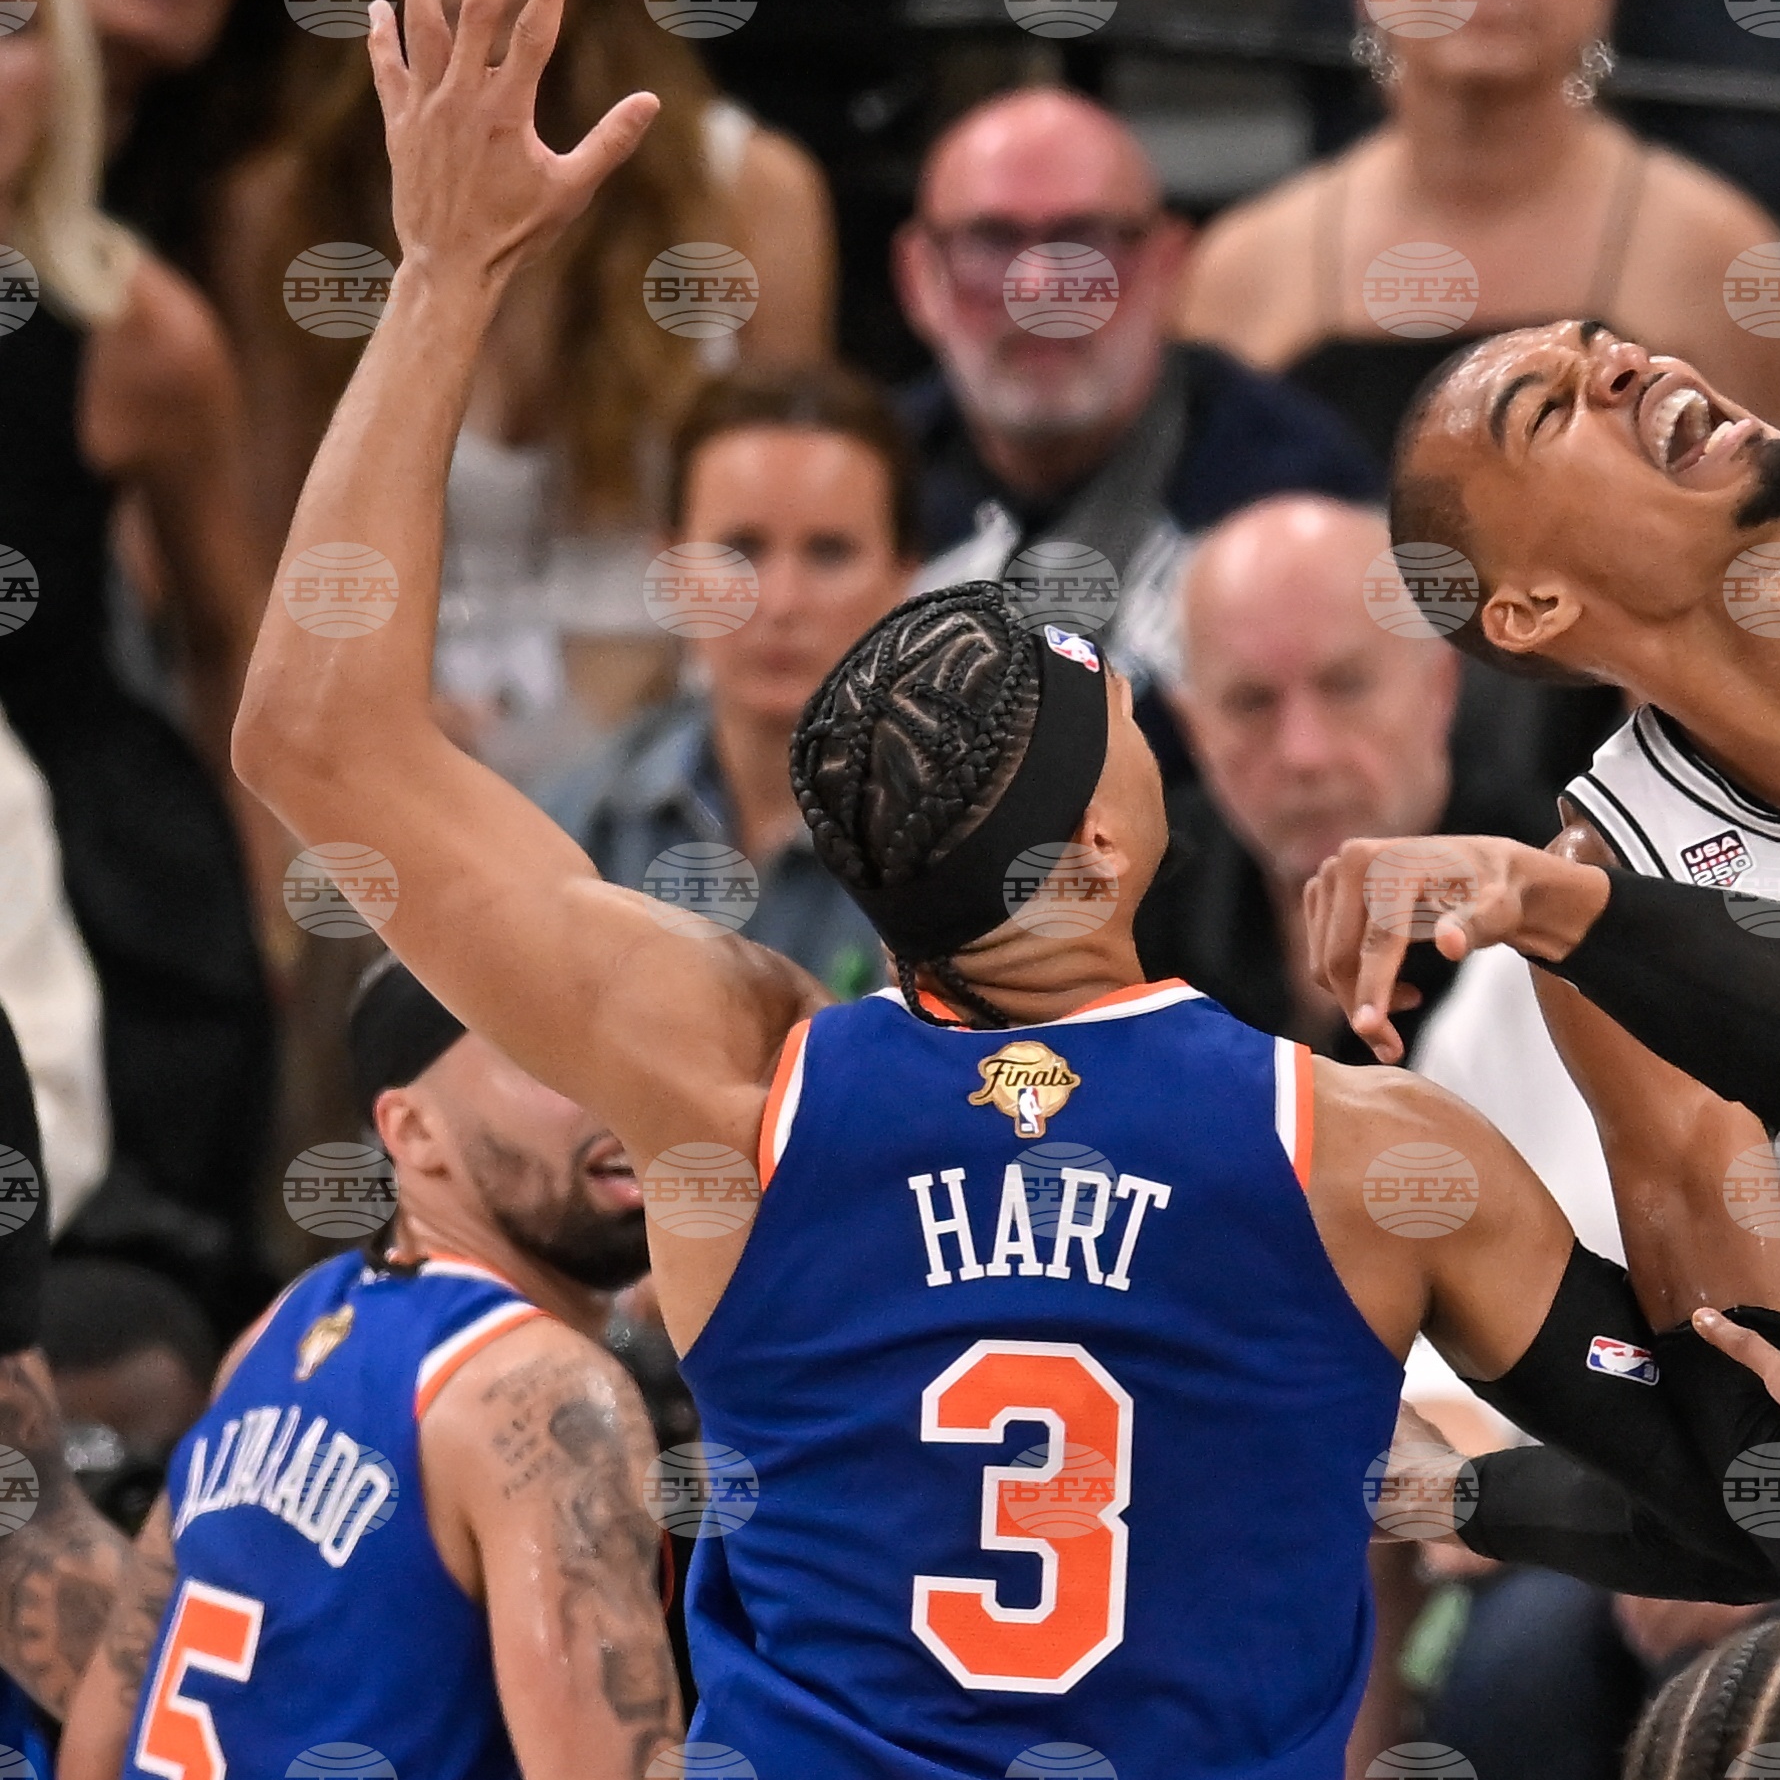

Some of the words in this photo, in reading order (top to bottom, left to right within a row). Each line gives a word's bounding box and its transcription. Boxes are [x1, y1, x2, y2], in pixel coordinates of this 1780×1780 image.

[1685, 835, 1740, 864] USA
[1693, 854, 1751, 887] 250
[973, 1059, 1076, 1101] Finals
[908, 1164, 1172, 1292] HART
[911, 1339, 1134, 1694] 3
